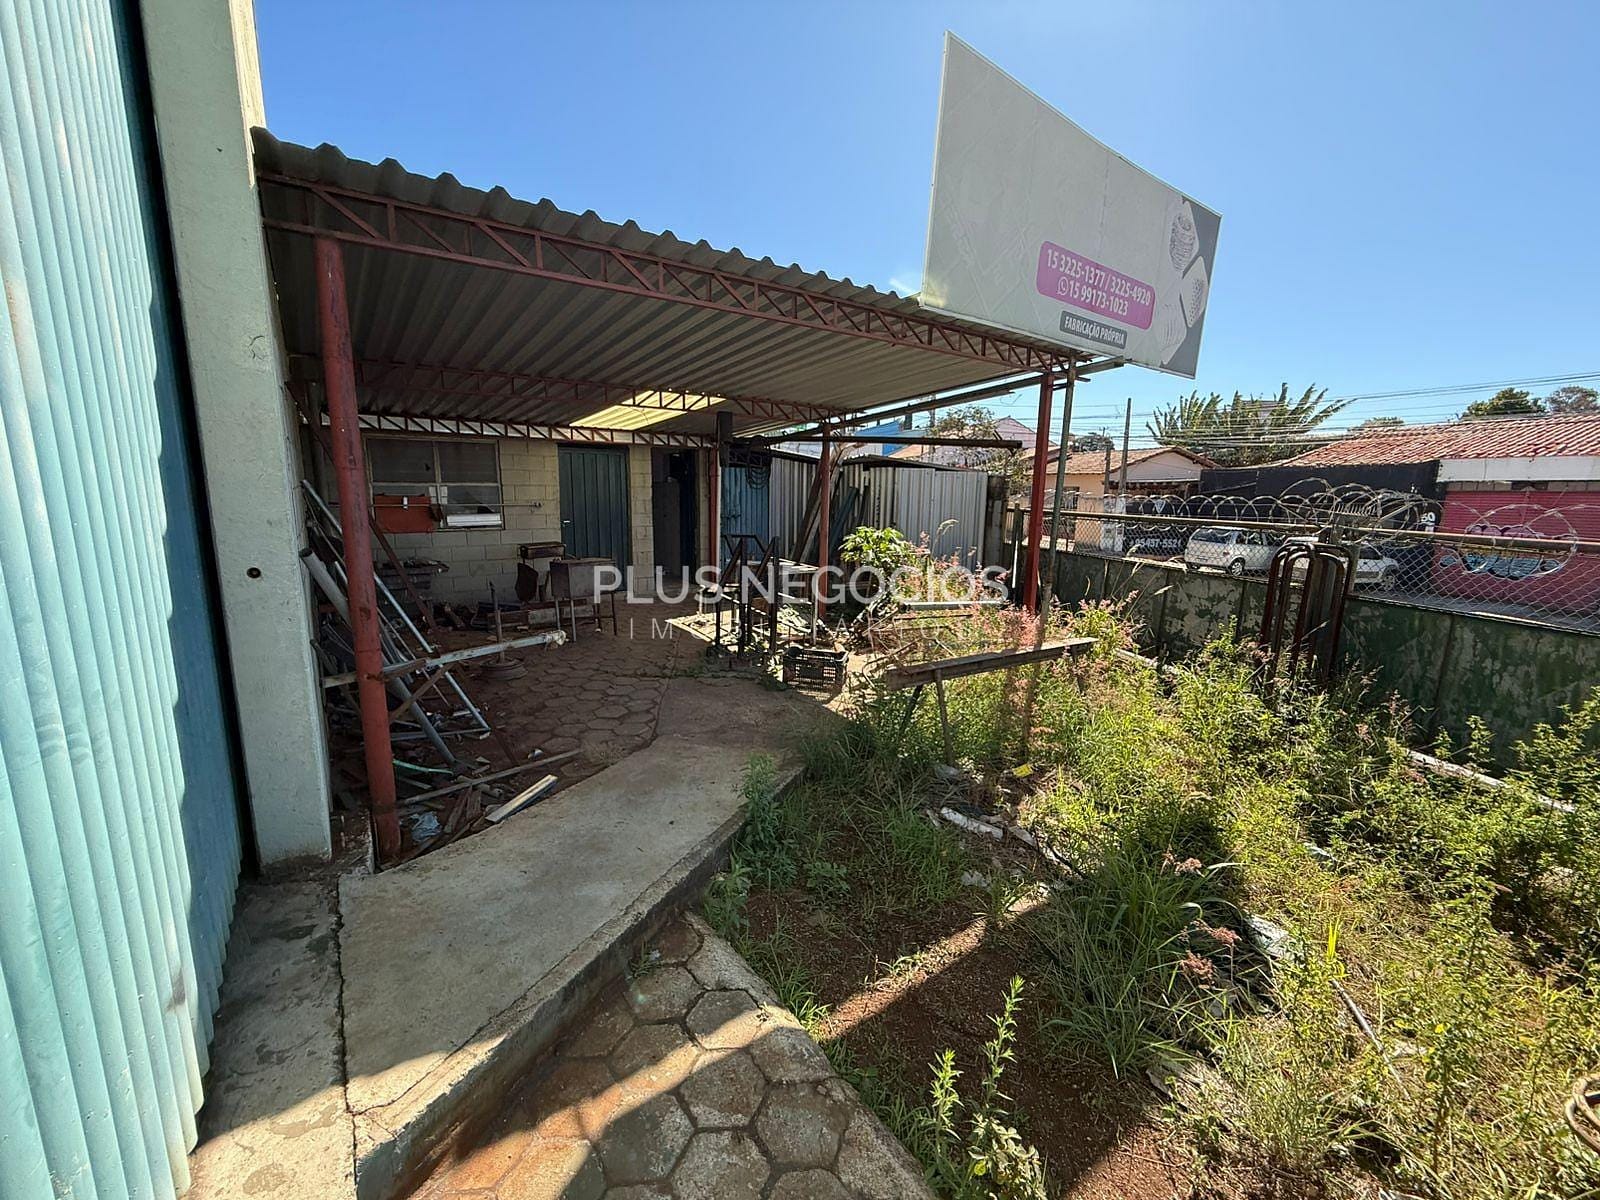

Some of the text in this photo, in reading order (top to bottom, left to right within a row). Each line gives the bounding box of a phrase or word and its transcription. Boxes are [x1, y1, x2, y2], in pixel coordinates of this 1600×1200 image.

[1047, 249, 1059, 269] 15
[1059, 254, 1105, 288] 3225-1377
[1110, 276, 1152, 306] 3225-4920
[1069, 280, 1129, 316] 15 99173-1023
[1064, 316, 1125, 345] FABRICAÇÃO PRÓPRIA
